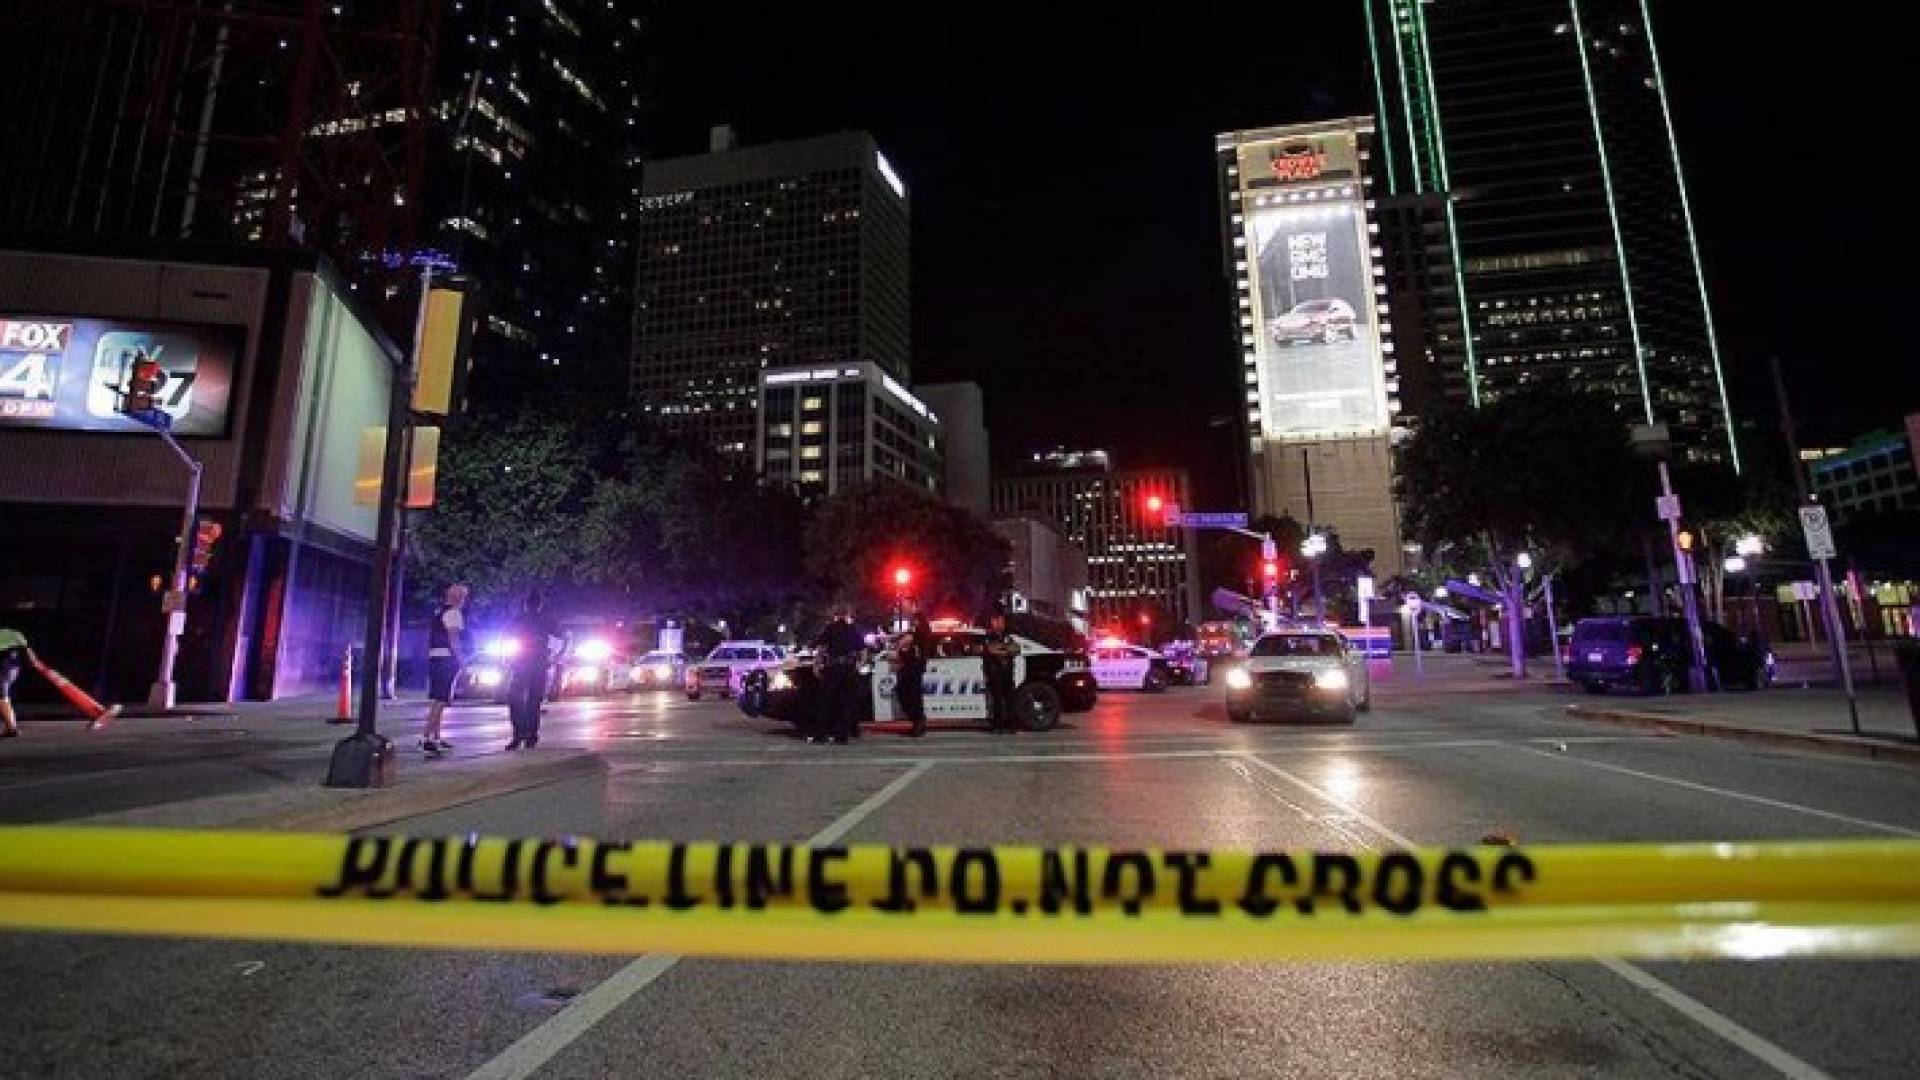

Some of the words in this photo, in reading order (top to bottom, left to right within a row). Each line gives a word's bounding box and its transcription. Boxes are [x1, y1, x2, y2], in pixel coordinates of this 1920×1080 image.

[3, 323, 66, 349] FOX
[0, 353, 49, 398] 4
[316, 838, 649, 906] POLICE
[662, 840, 852, 914] LINE
[871, 847, 1002, 914] DO
[1012, 848, 1221, 917] NOT
[1237, 850, 1536, 918] CROSS
